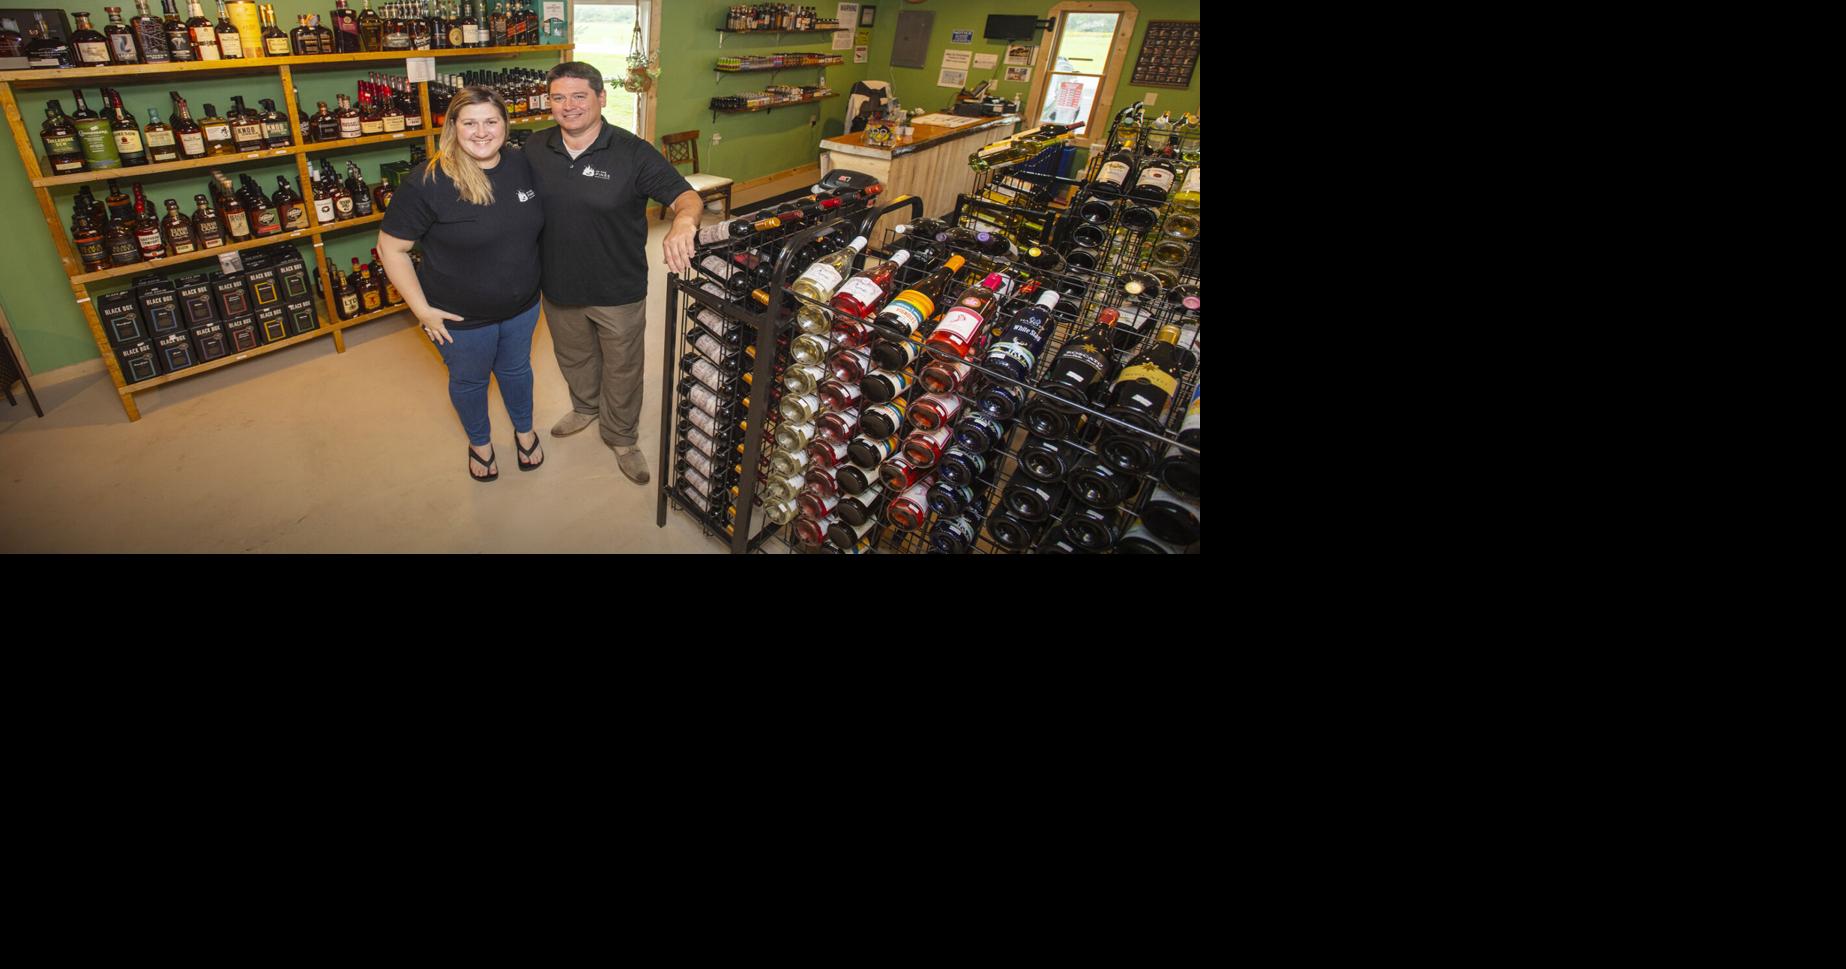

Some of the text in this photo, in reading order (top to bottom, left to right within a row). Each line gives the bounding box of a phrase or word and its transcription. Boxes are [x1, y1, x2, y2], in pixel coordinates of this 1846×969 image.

[281, 265, 293, 273] BLACK
[250, 272, 264, 280] BLACK
[219, 282, 233, 290] BLACK
[182, 286, 207, 296] BLACK BOX
[146, 295, 173, 306] BLACK BOX
[104, 304, 133, 316] BLACK BOX
[260, 311, 273, 319] BLACK
[228, 320, 242, 328] BLACK
[196, 327, 211, 336] BLACK
[1013, 324, 1031, 334] White
[1029, 329, 1042, 342] Stag
[123, 344, 150, 357] BLACK BOX
